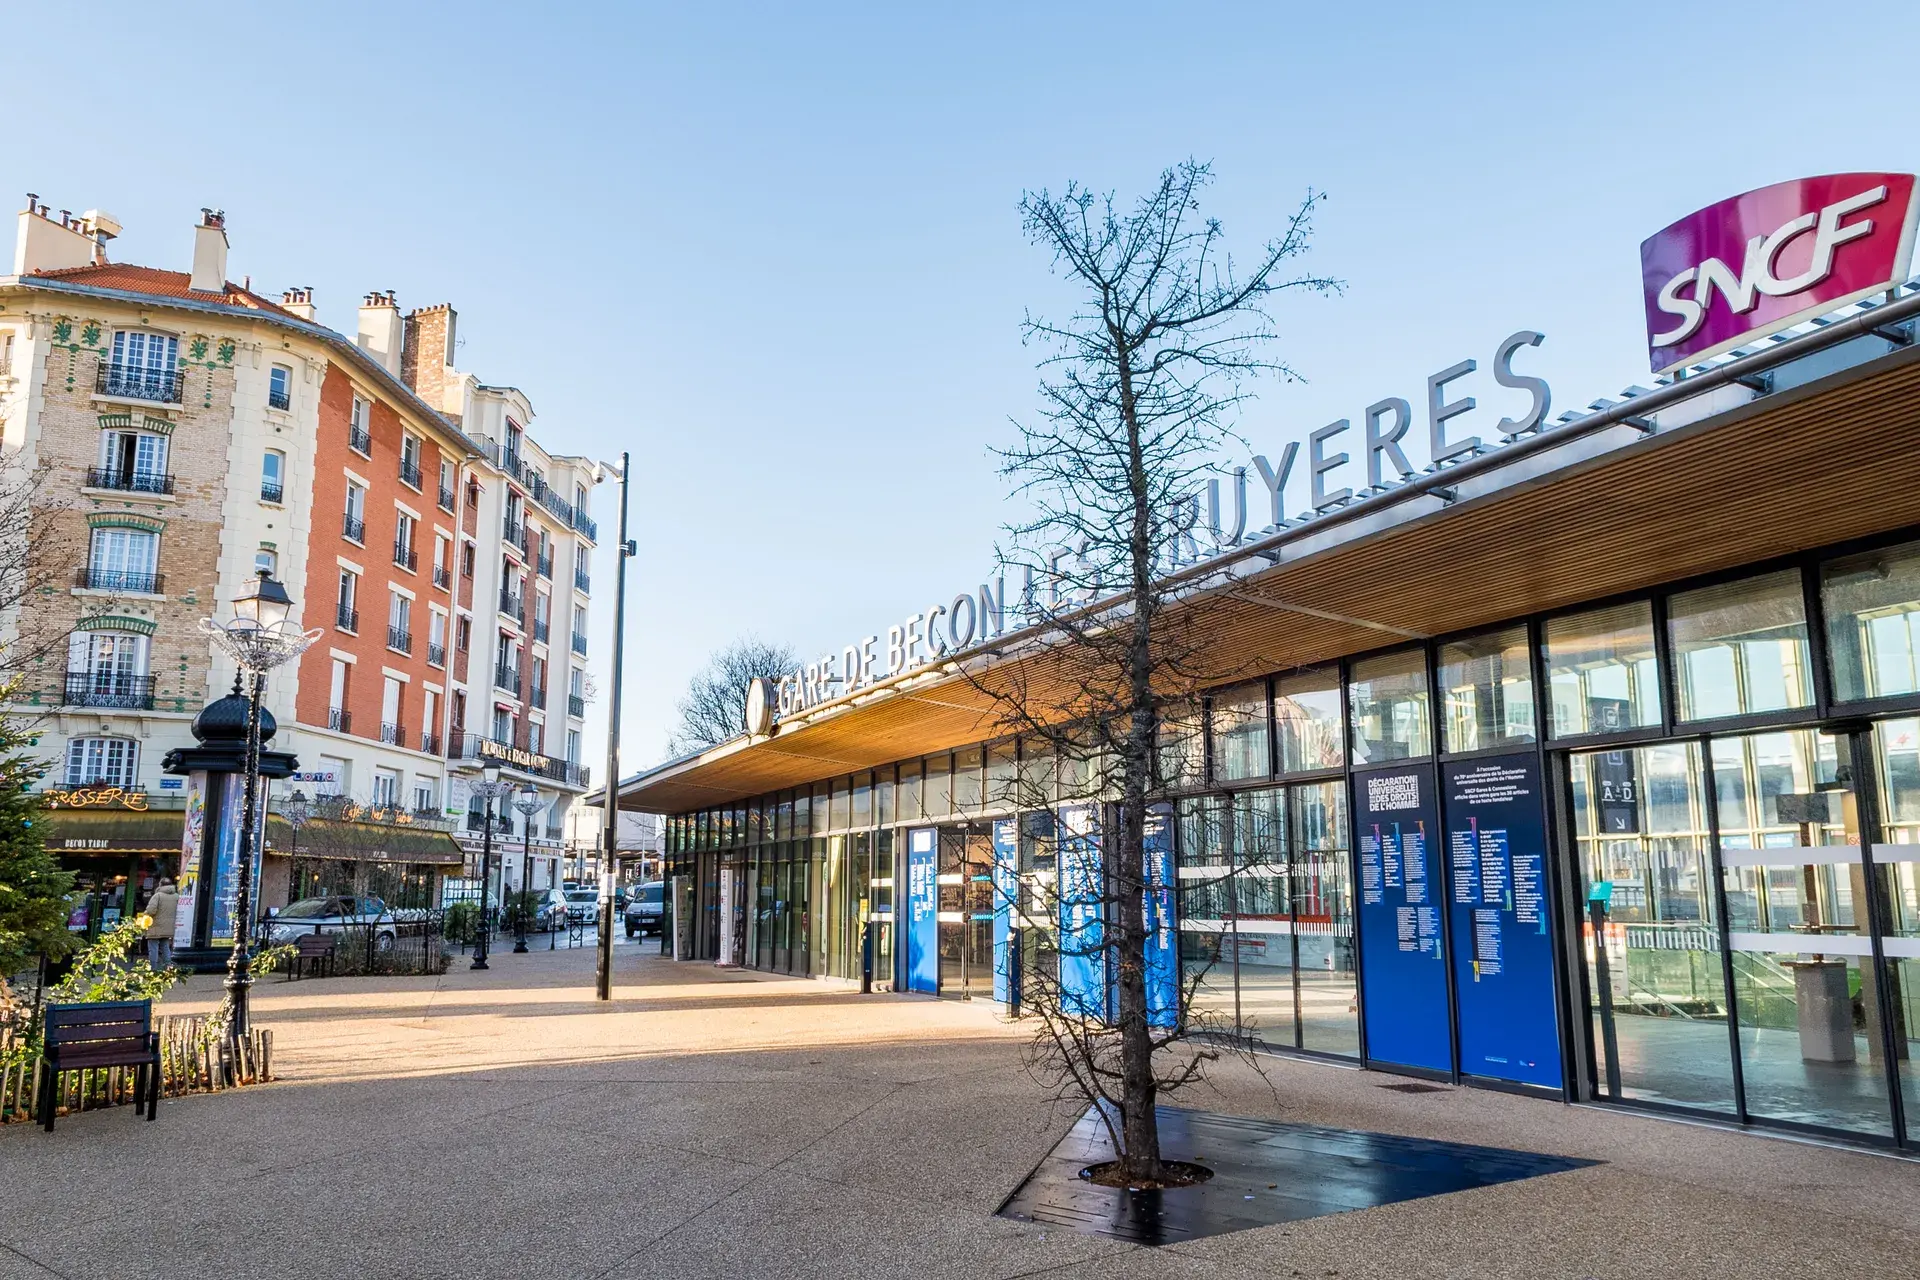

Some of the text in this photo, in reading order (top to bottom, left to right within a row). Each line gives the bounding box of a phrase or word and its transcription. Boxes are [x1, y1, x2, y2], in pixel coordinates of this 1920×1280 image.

[1651, 185, 1887, 348] SNCF
[778, 655, 836, 717] GARE
[842, 635, 878, 692] DE
[888, 577, 1005, 675] BECON
[293, 772, 335, 782] LOTO
[1368, 775, 1416, 788] DÉCLARATION
[1369, 783, 1416, 796] UNIVERSELLE
[1604, 786, 1613, 799] A
[1623, 787, 1632, 800] D
[1375, 794, 1390, 803] DES
[1390, 791, 1416, 802] DROITS
[1369, 800, 1416, 812] DE L'HOMME
[88, 839, 109, 849] TABAC
